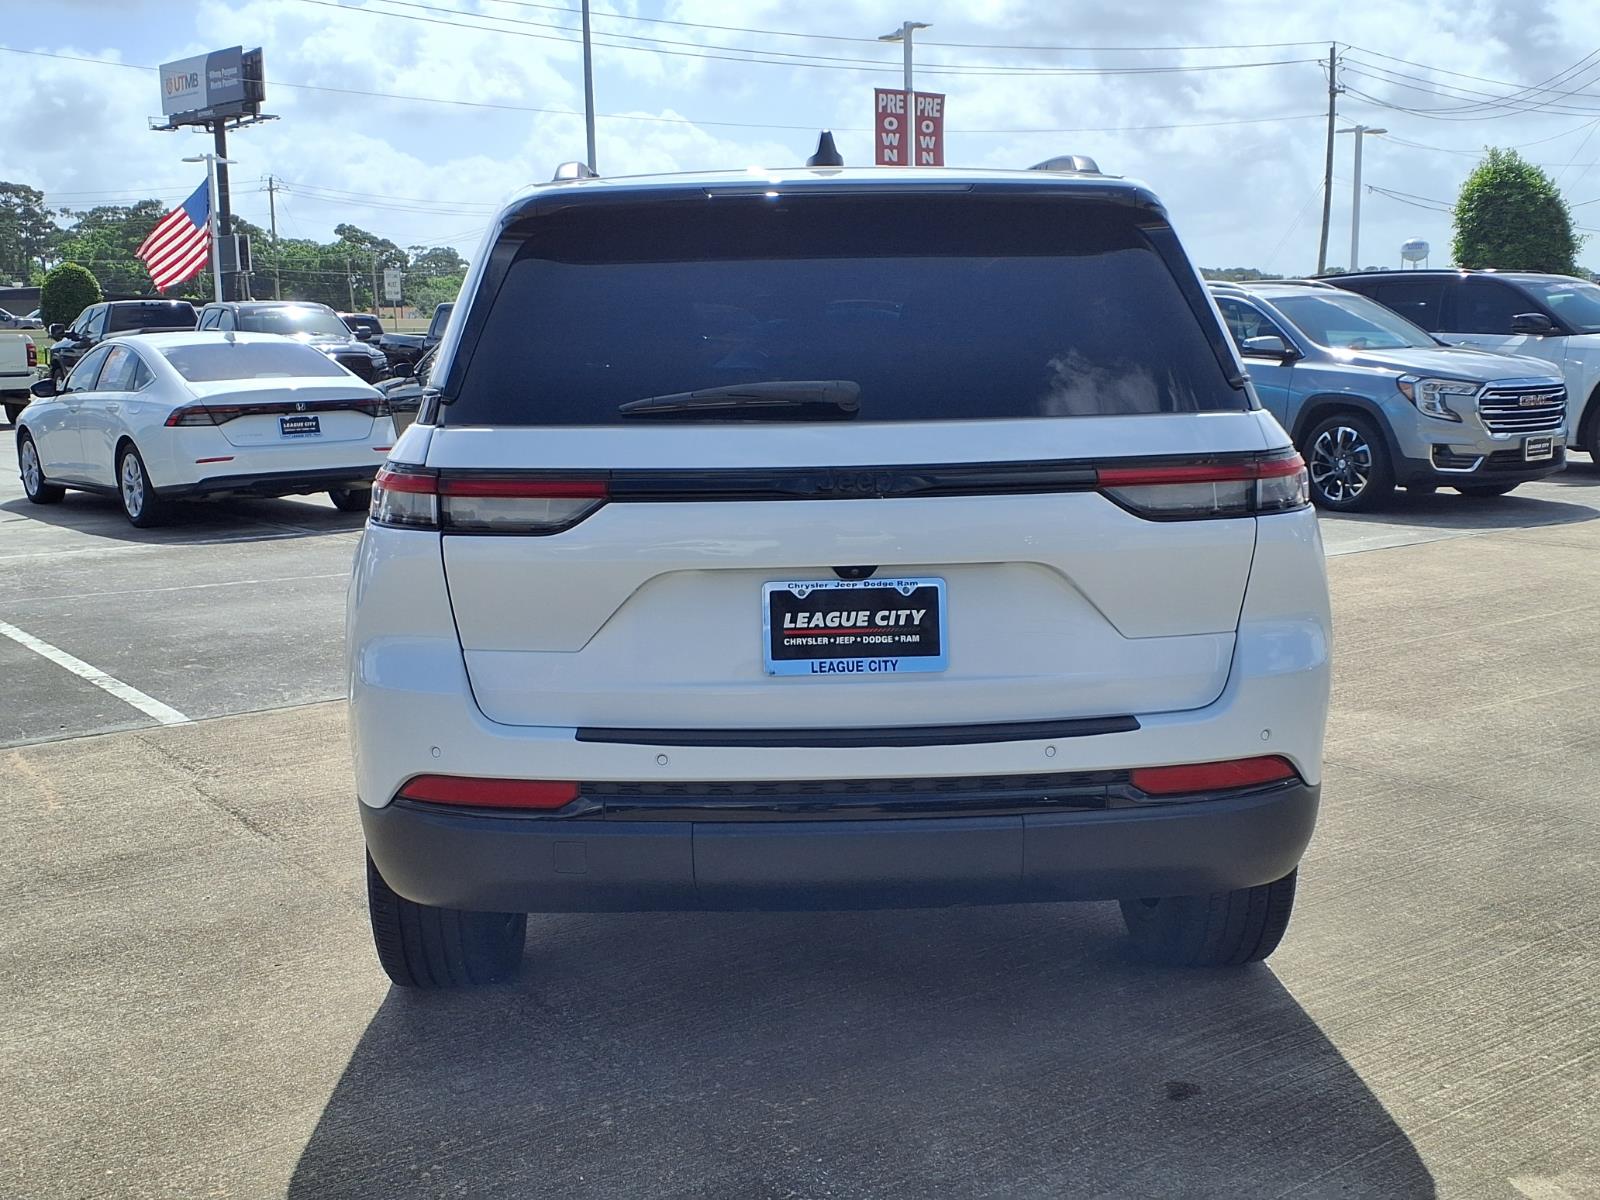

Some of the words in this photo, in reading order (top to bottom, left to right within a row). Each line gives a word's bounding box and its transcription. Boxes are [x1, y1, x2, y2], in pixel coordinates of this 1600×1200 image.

[174, 72, 199, 92] UTMB
[878, 93, 905, 114] PRE
[916, 96, 942, 118] PRE
[1519, 394, 1553, 407] GMC
[787, 582, 829, 590] Chrysler
[834, 581, 858, 589] Jeep
[863, 580, 894, 588] Dodge
[783, 610, 870, 629] LEAGUE
[874, 609, 927, 626] CITY
[783, 636, 829, 646] CHRYSLER
[835, 636, 856, 645] JEEP
[862, 635, 894, 644] DODGE
[900, 635, 920, 643] RAM
[811, 660, 864, 674] LEAGUE
[868, 659, 899, 673] CITY
